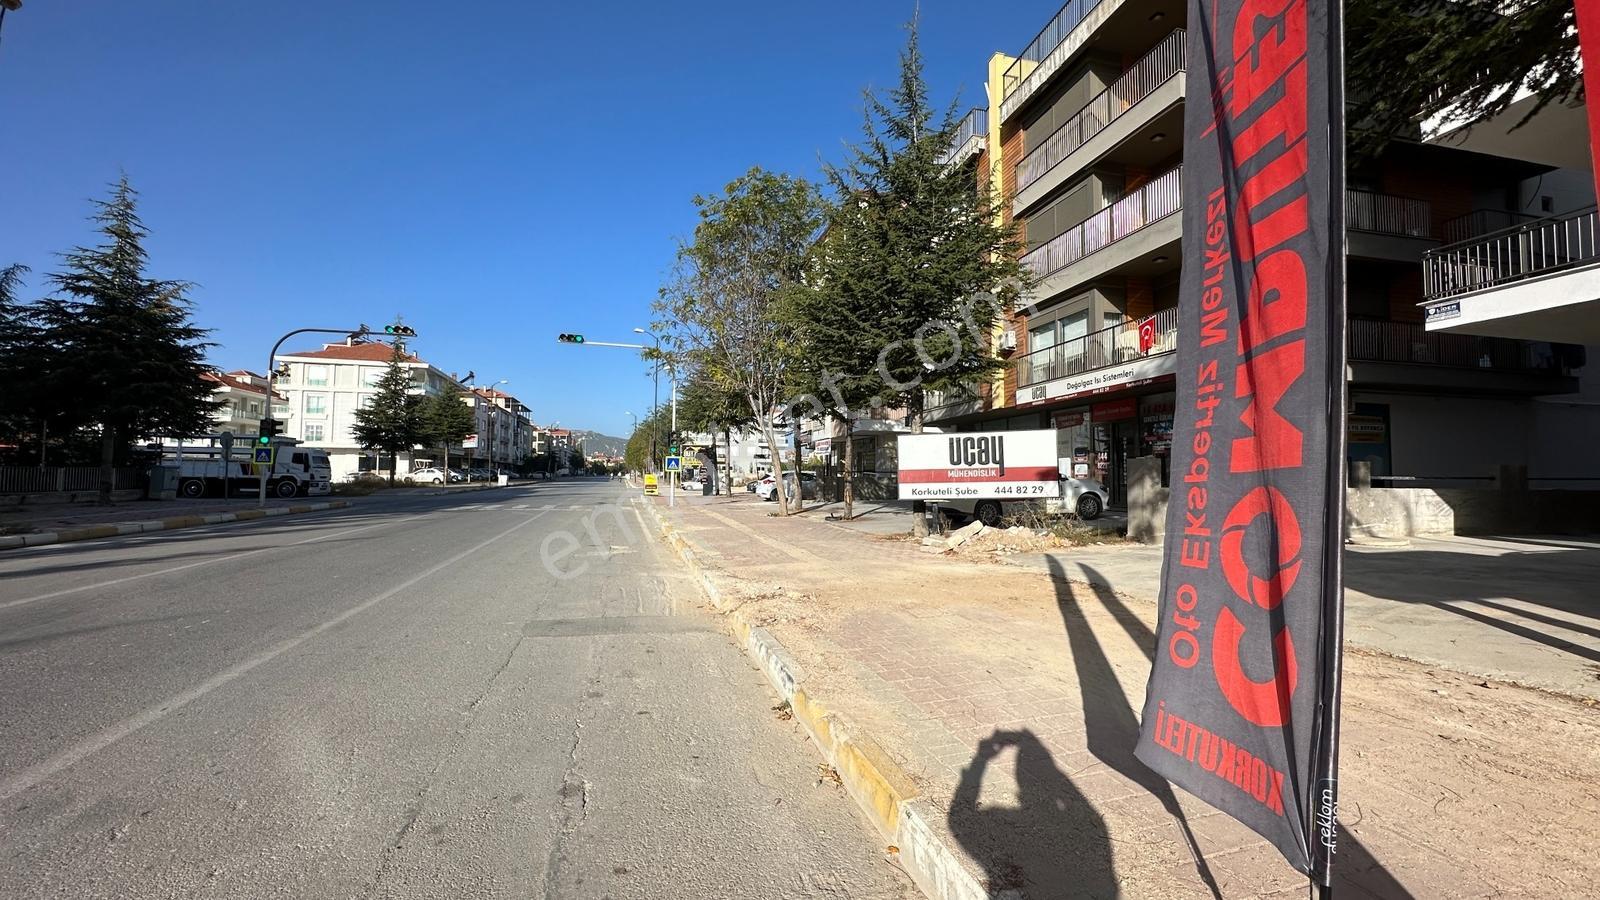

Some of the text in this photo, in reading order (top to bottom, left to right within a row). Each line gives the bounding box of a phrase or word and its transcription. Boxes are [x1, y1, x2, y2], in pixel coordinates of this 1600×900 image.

[1066, 378, 1093, 390] Doğalgaz
[1102, 368, 1134, 383] Sistemleri
[947, 467, 997, 478] MÜHENDİSLİK
[911, 485, 1044, 497] Korkuteli Şube 444 82 29
[1316, 788, 1334, 847] reklam
